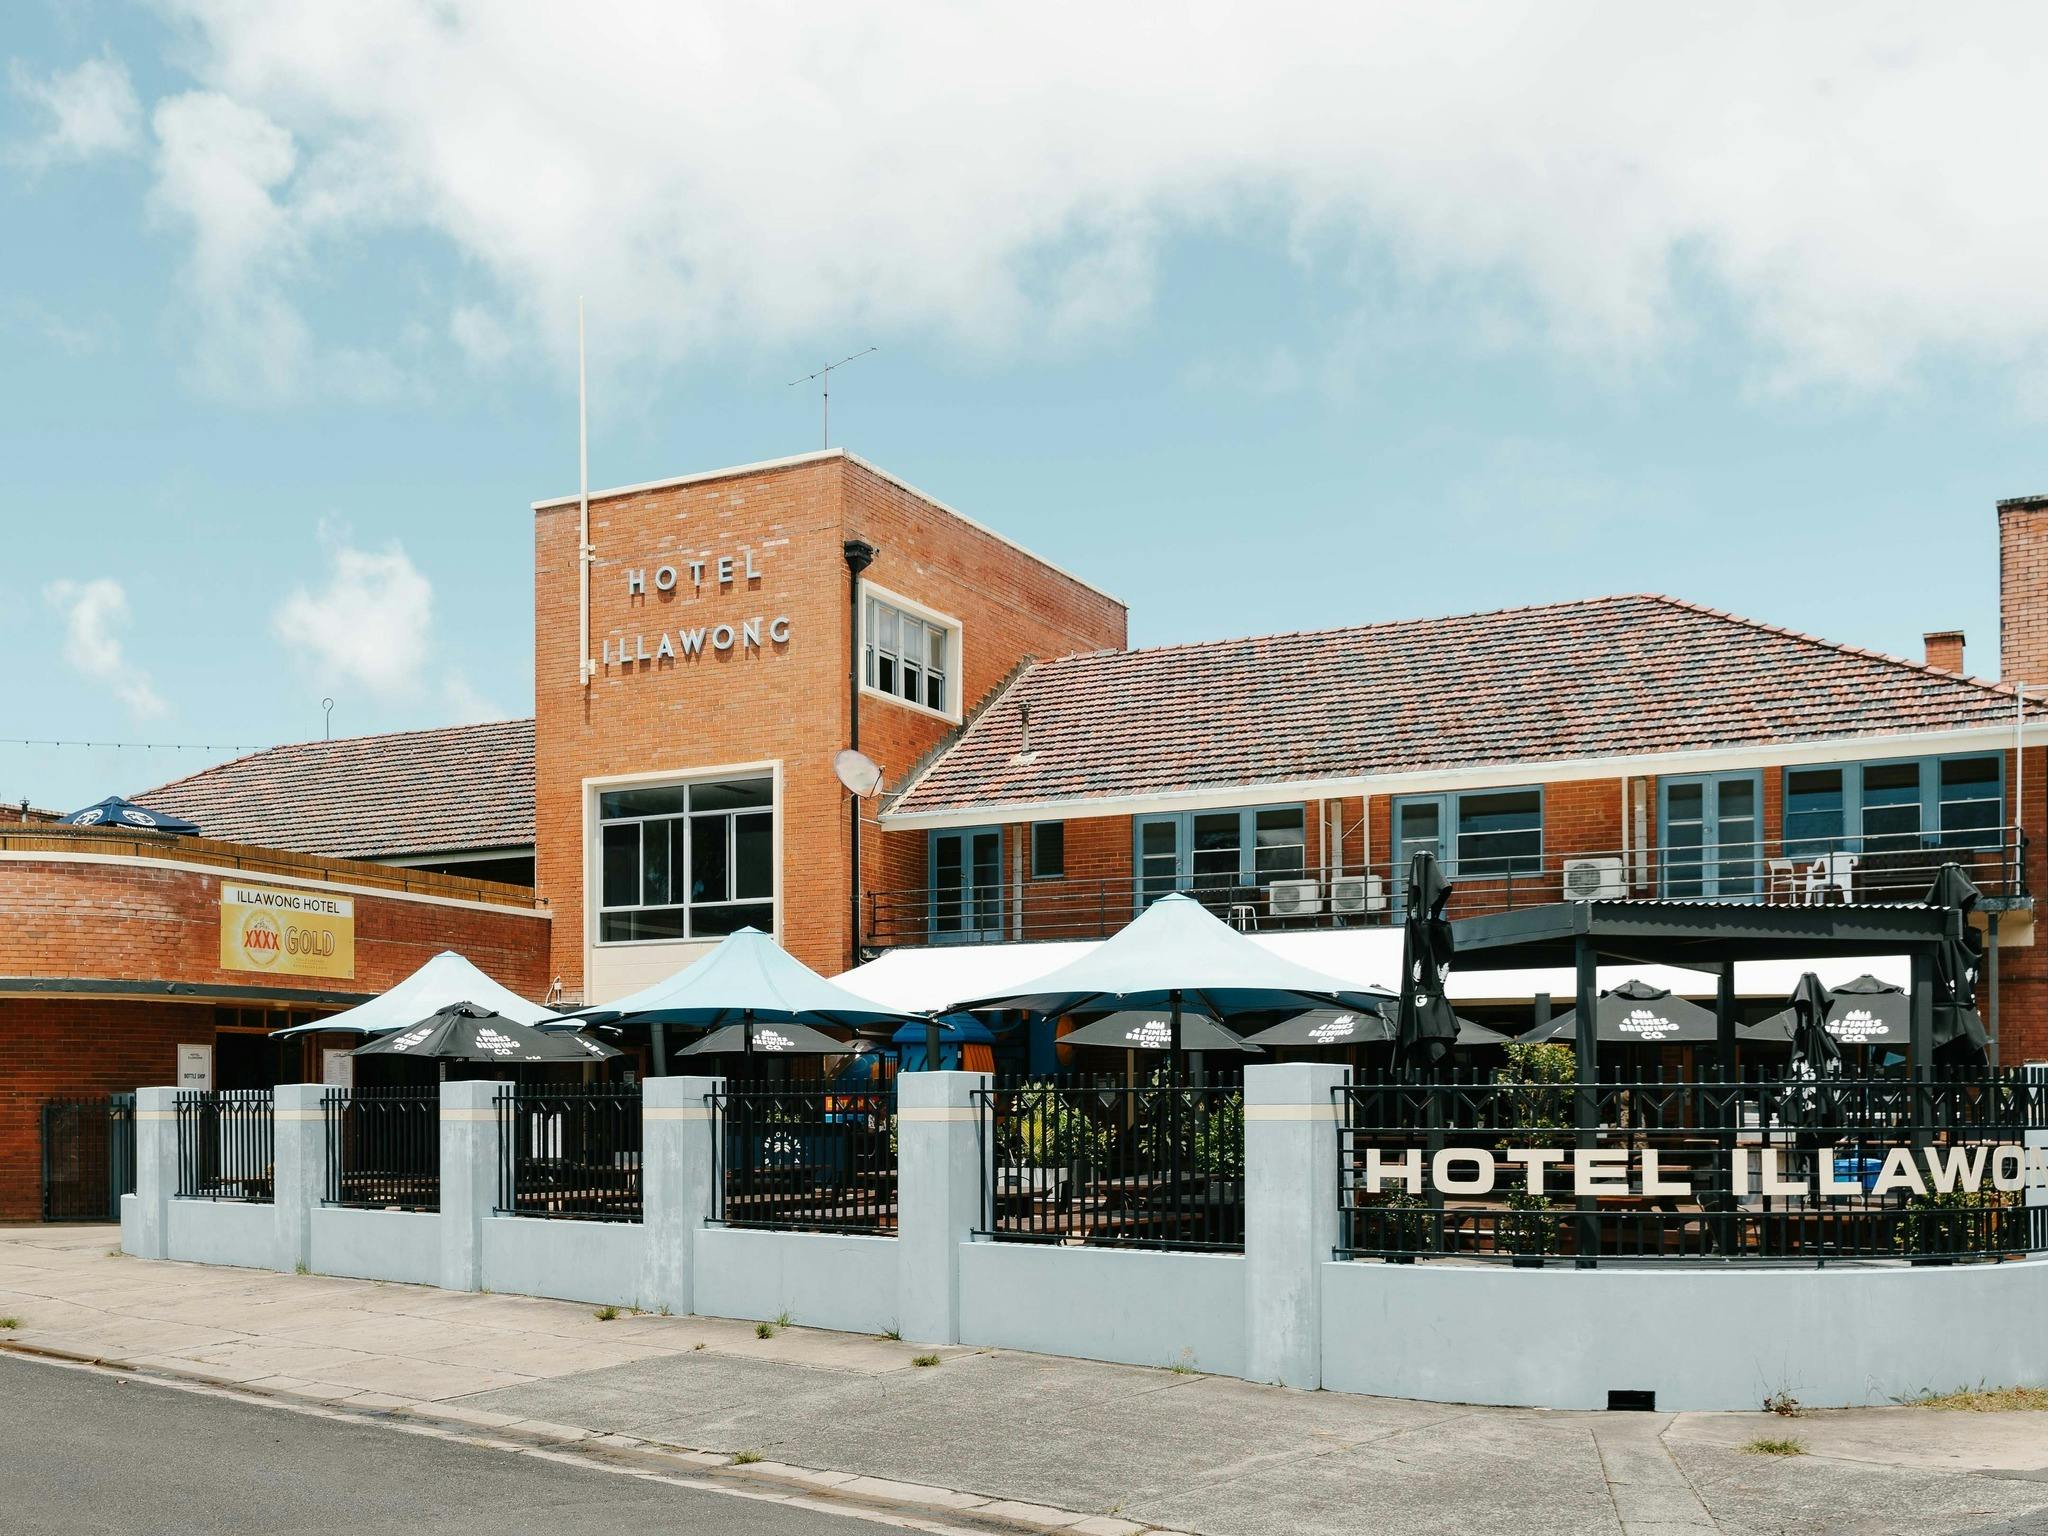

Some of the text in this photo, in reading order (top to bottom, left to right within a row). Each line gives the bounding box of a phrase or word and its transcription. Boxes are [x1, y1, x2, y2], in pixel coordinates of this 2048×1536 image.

[627, 546, 761, 595] HOTEL
[602, 615, 791, 664] ILLAWONG
[237, 890, 340, 914] ILLAWONG HOTEL
[243, 926, 335, 957] XXXX GOLD
[1619, 1024, 1680, 1032] BREWING
[1631, 1018, 1669, 1026] PINES
[1841, 1019, 1882, 1028] PINES
[475, 1040, 520, 1049] BREWING
[482, 1035, 511, 1043] PINES
[1366, 1147, 1692, 1196] HOTEL
